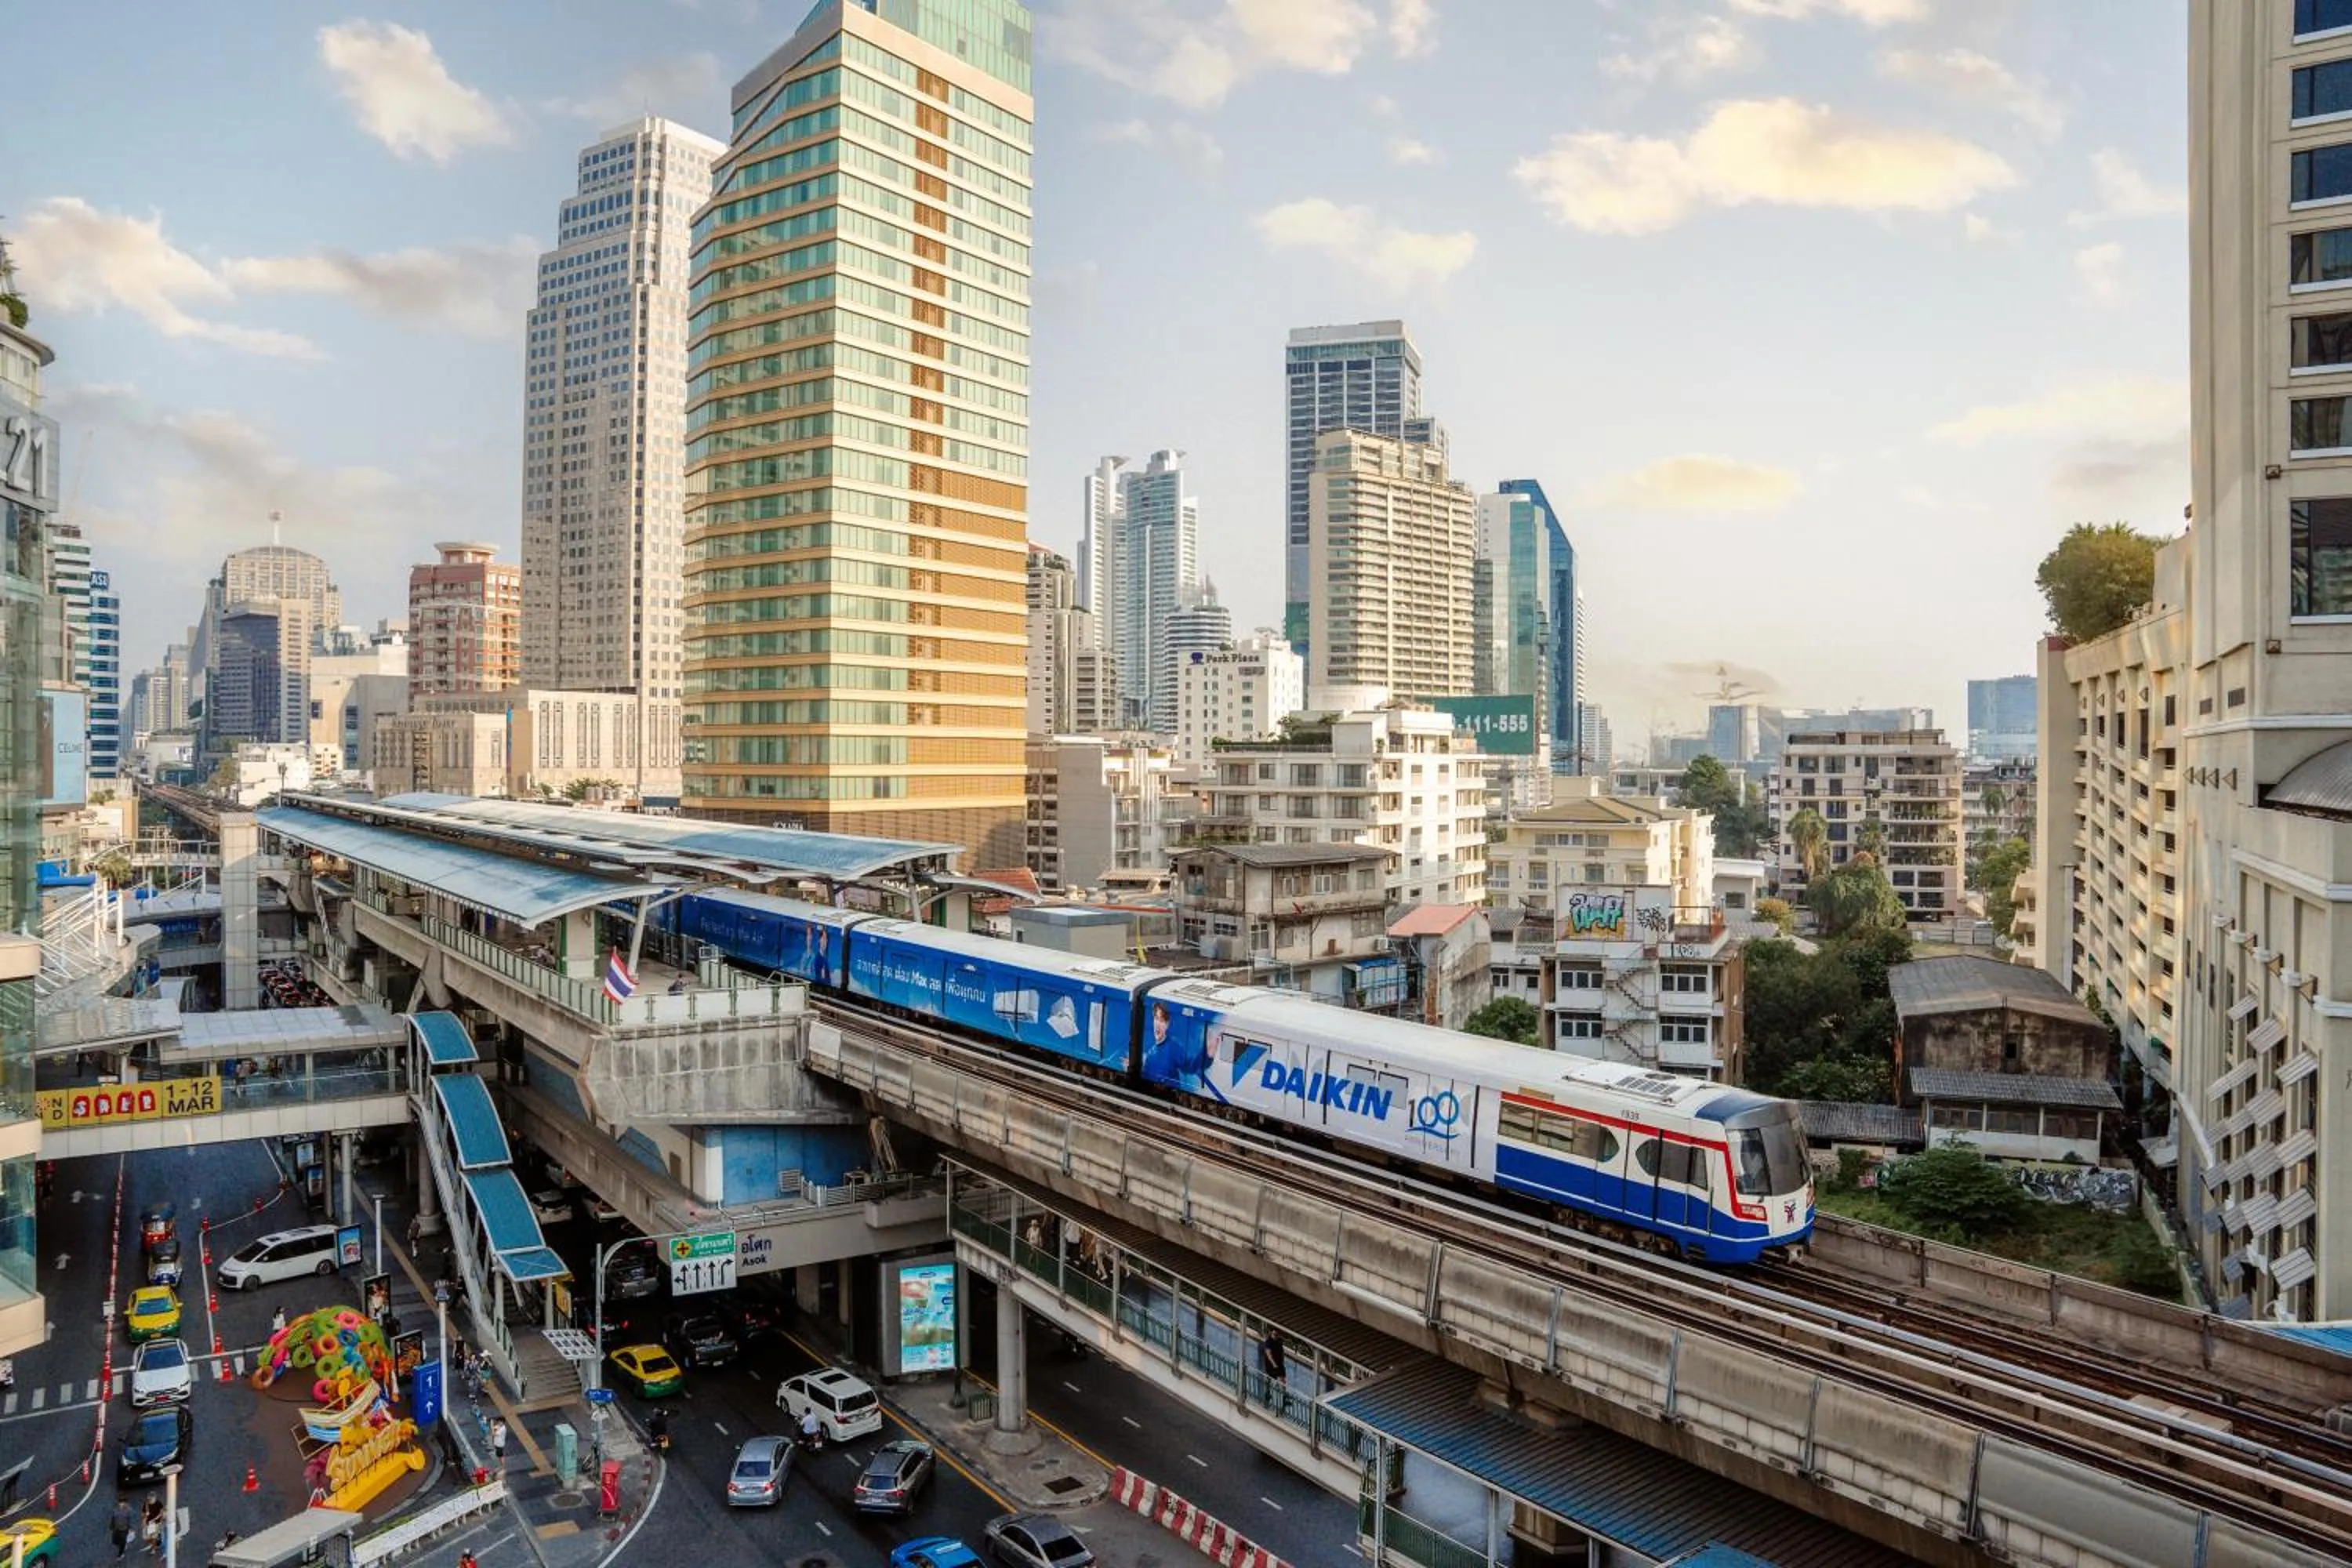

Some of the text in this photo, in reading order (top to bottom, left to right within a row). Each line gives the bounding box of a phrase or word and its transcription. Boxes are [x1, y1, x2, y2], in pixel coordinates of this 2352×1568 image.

[6, 416, 48, 498] 21
[1261, 1059, 1393, 1121] DAIKIN
[168, 1098, 214, 1114] MAR
[1408, 1091, 1459, 1127] 100
[741, 1234, 771, 1254] อโศก
[742, 1254, 767, 1267] Asok
